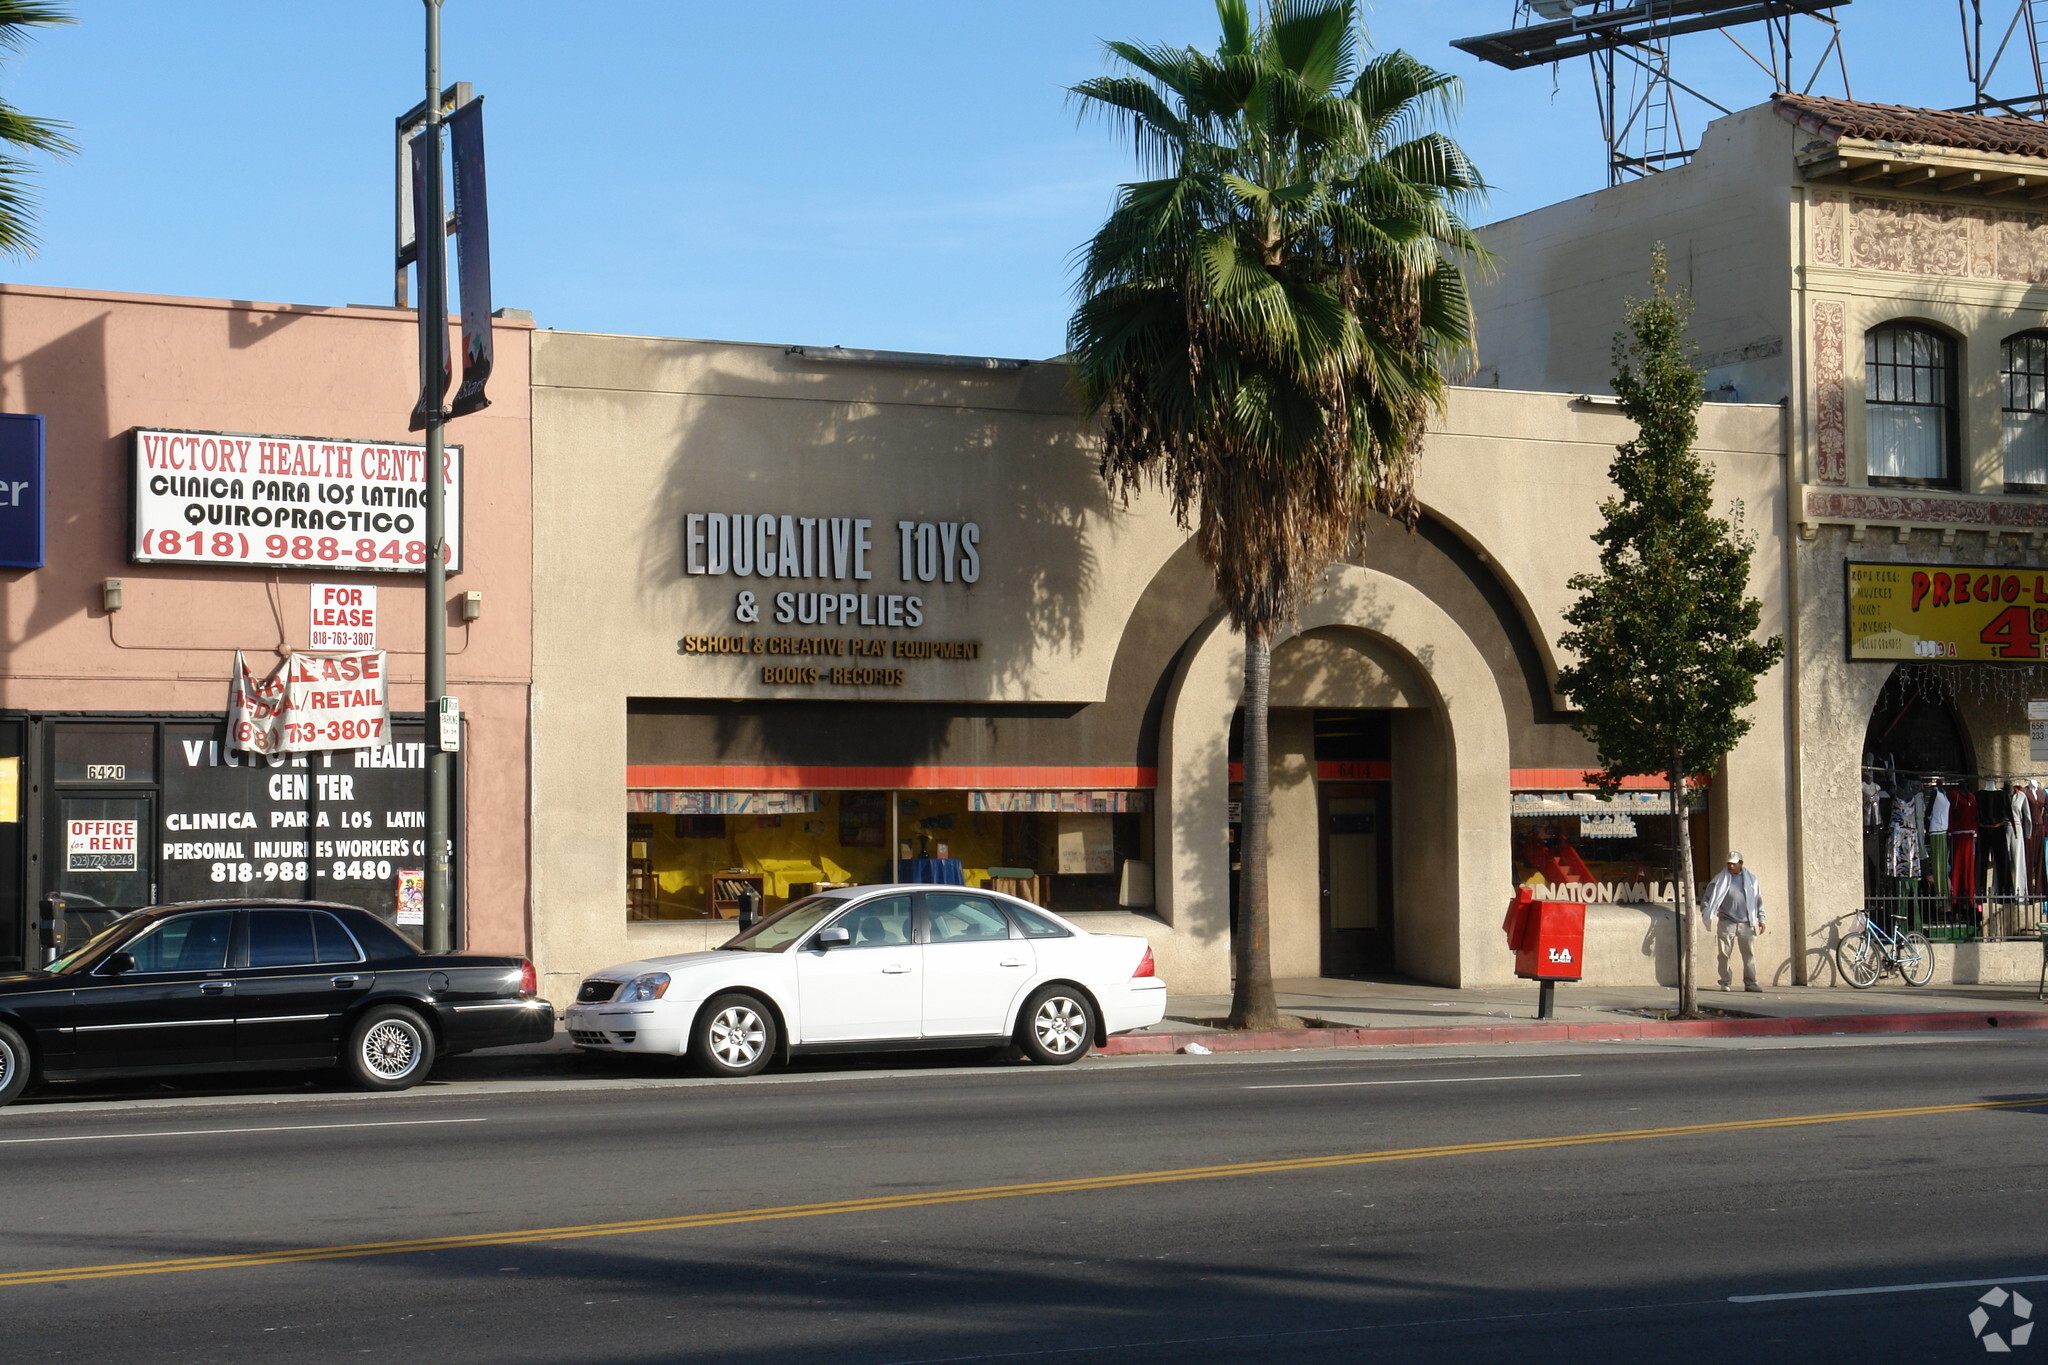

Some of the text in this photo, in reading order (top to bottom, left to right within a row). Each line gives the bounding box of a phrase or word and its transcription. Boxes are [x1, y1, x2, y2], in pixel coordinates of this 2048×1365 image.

[143, 435, 452, 484] VICTORY HEALTH CENTR
[150, 475, 446, 508] CLINICA PARA LOS LATIN
[184, 503, 414, 534] QUIROPRACTICO
[142, 529, 249, 559] (818)
[685, 512, 980, 583] EDUCATIVE TOYS
[324, 588, 362, 606] FOR
[735, 590, 924, 627] & SUPPLIES
[313, 608, 373, 627] LEASE
[312, 631, 374, 646] 818-763-3807
[684, 635, 983, 660] SCHOOL & CREATIVE PLAY EQUIPMENT
[88, 766, 124, 779] 6420
[268, 774, 354, 801] CENTER
[71, 822, 134, 836] OFFICE
[166, 812, 258, 831] CLINICA
[270, 811, 330, 828] PARA
[341, 811, 372, 828] LOS
[70, 837, 135, 852] for RENT
[163, 842, 245, 860] PERSONAL
[254, 841, 333, 858] INJURIES
[335, 838, 409, 857] WORKER'S
